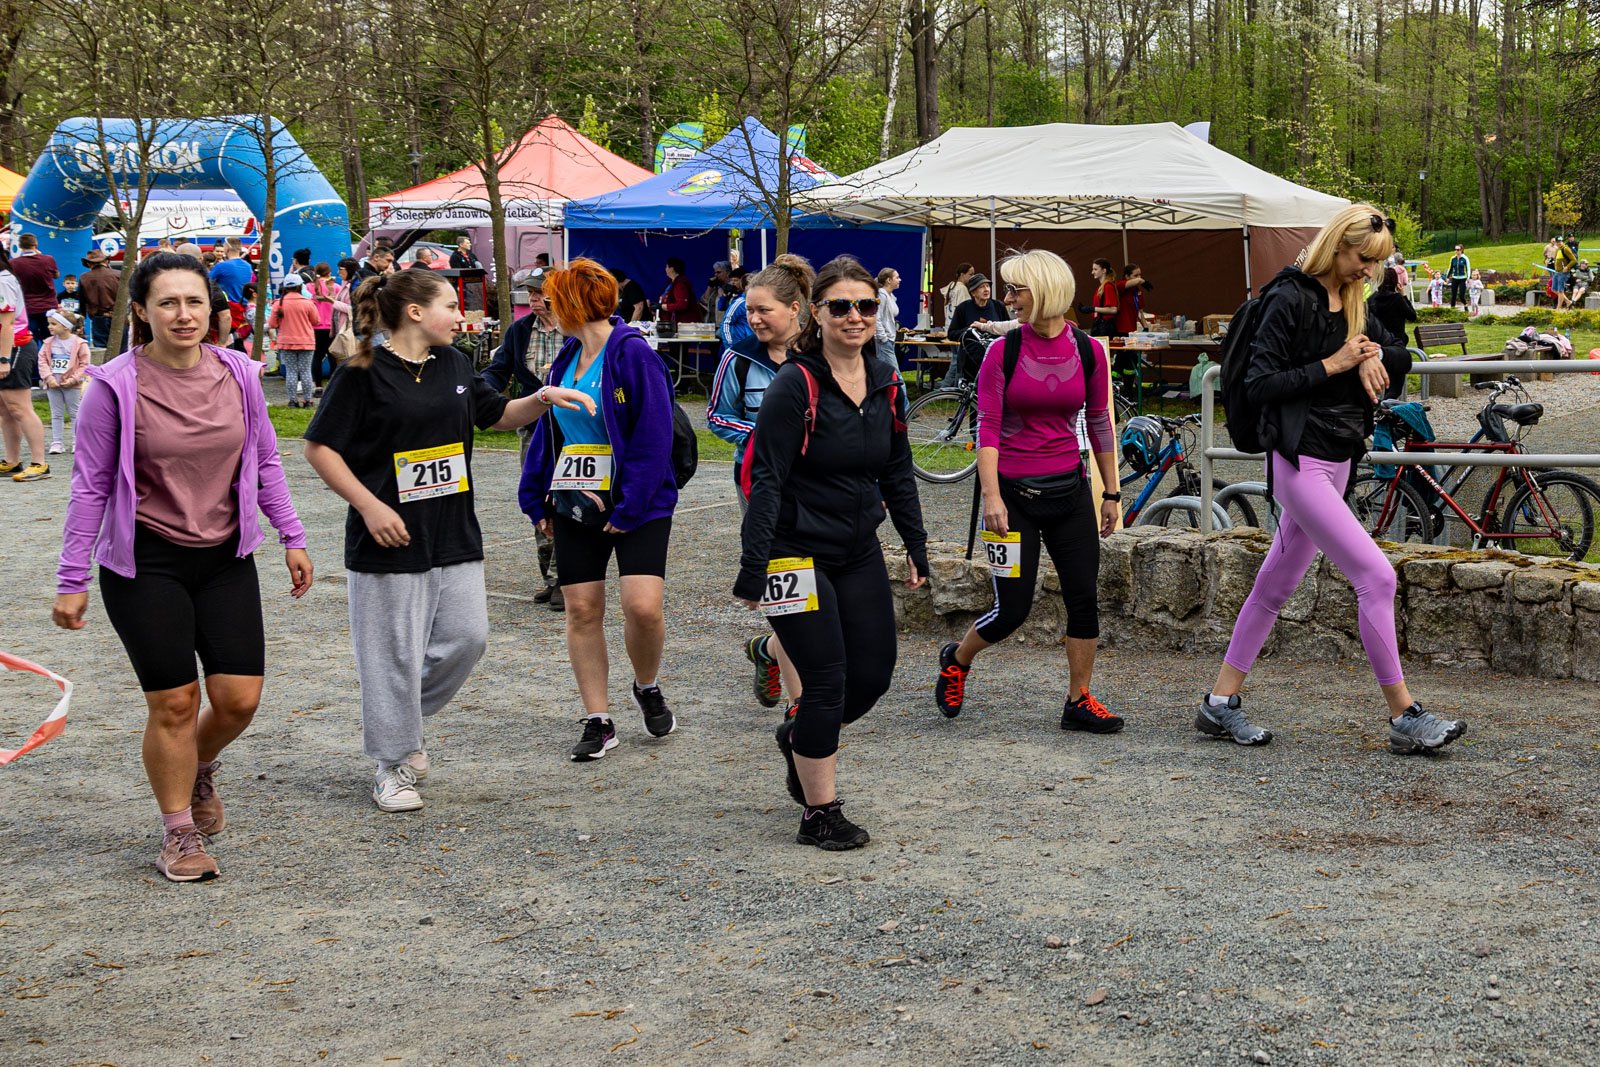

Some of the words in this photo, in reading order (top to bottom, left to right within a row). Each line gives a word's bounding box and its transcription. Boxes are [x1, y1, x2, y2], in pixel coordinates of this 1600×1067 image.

[75, 141, 205, 173] DECATLON
[396, 209, 442, 220] Sołectwo
[445, 206, 490, 218] Janowic
[505, 207, 538, 218] ielkie
[412, 459, 452, 487] 215
[562, 456, 596, 478] 216
[984, 543, 1007, 565] 63
[763, 572, 800, 602] 62
